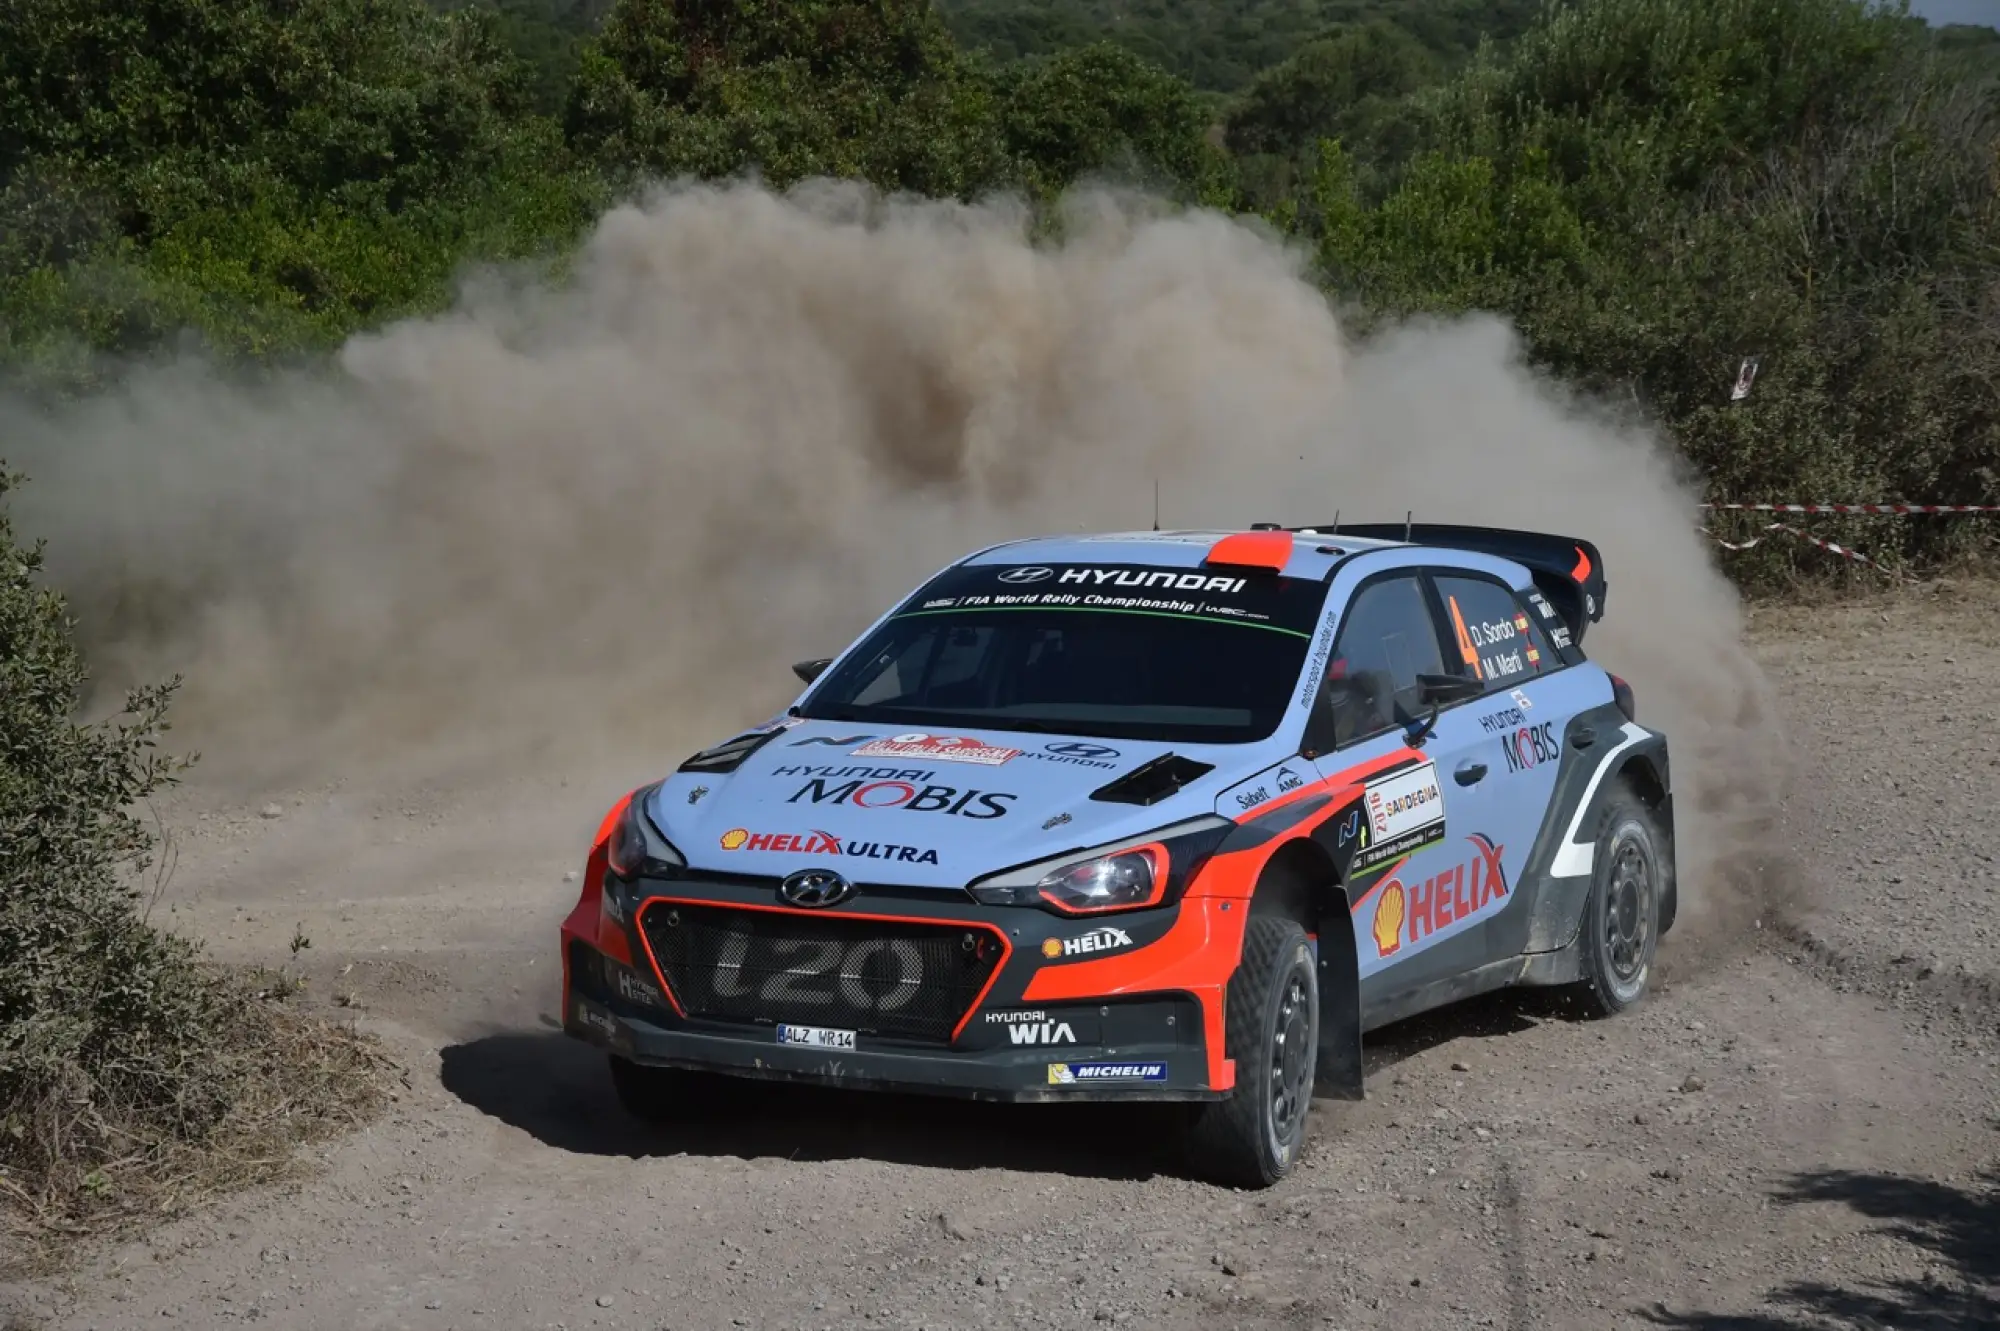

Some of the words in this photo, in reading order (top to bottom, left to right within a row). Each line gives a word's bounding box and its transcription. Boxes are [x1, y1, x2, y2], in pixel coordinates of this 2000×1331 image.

[1058, 568, 1247, 593] HYUNDAI
[964, 596, 989, 606] FIA
[994, 594, 1040, 604] World
[1042, 593, 1081, 605] Rally
[1083, 594, 1195, 612] Championship
[1449, 595, 1483, 680] 4
[1482, 617, 1515, 644] Sordo
[1478, 707, 1527, 734] HYUNDAI
[1018, 751, 1117, 769] HYUNDAI
[1501, 721, 1559, 773] MOBIS
[771, 765, 936, 782] HYUNDAI
[784, 778, 1018, 820] MOBIS
[1386, 784, 1439, 817] SARDEGNA
[746, 829, 843, 855] HELIX
[847, 840, 939, 865] ULTRA
[1409, 832, 1509, 943] HELIX
[1063, 927, 1134, 955] HELIX
[986, 1010, 1045, 1023] HYUNDAI
[786, 1027, 810, 1043] ALZ
[1008, 1018, 1077, 1045] WIA
[1078, 1065, 1162, 1077] MICHELIN
